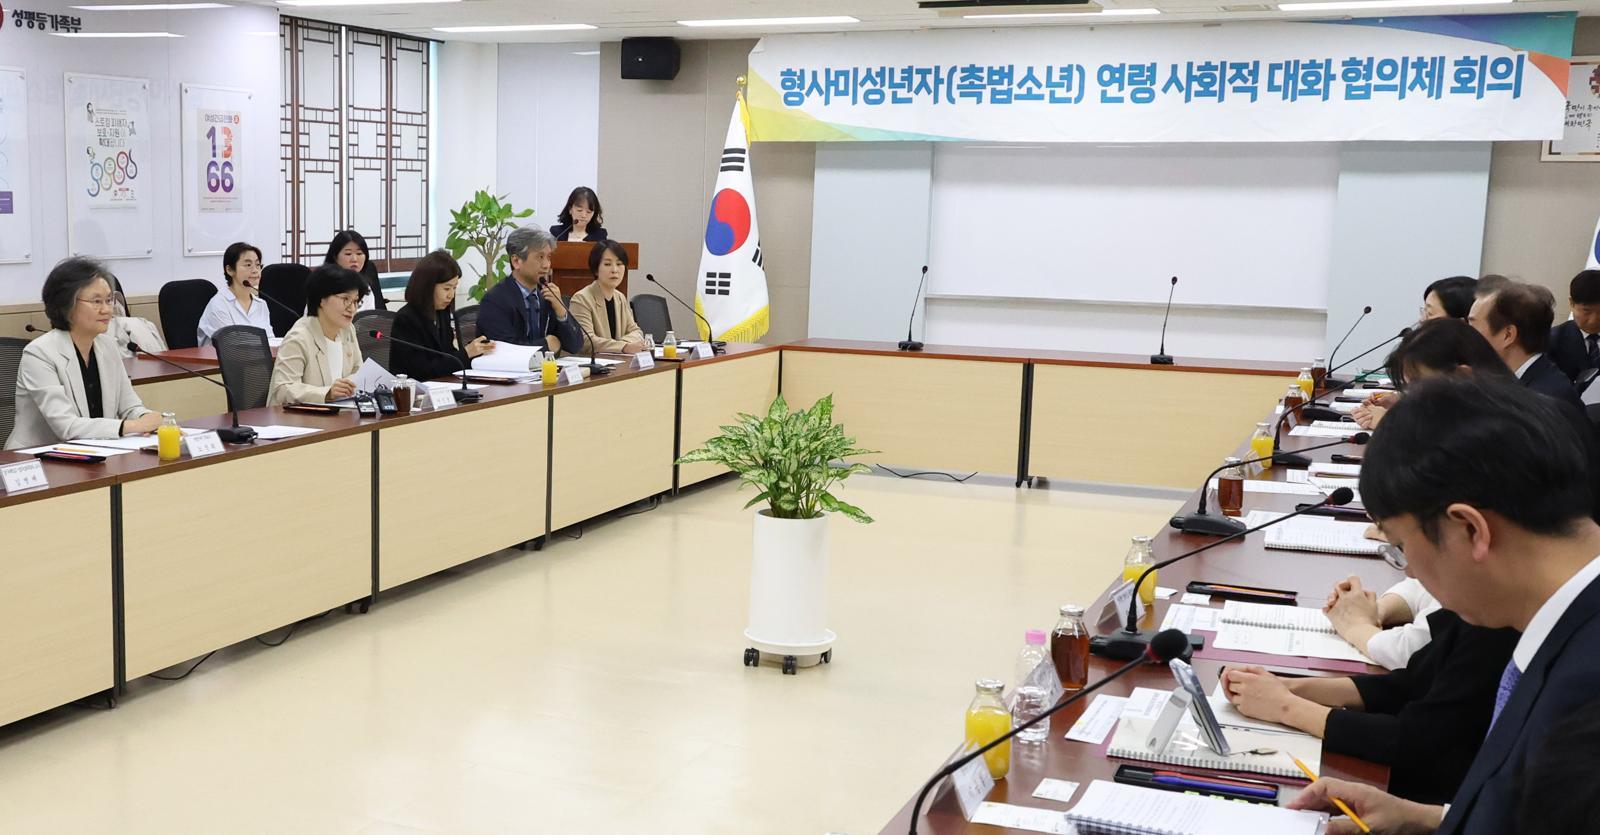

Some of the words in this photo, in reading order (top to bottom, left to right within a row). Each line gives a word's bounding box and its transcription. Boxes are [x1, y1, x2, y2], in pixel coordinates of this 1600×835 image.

[12, 9, 82, 33] 성평등가족부
[780, 63, 1086, 107] 형사미성년자(촉법소년)
[1096, 62, 1157, 104] 연령
[1161, 60, 1260, 104] 사회적
[1266, 58, 1336, 103] 대화
[1341, 56, 1446, 101] 협의체
[1450, 54, 1525, 100] 회의
